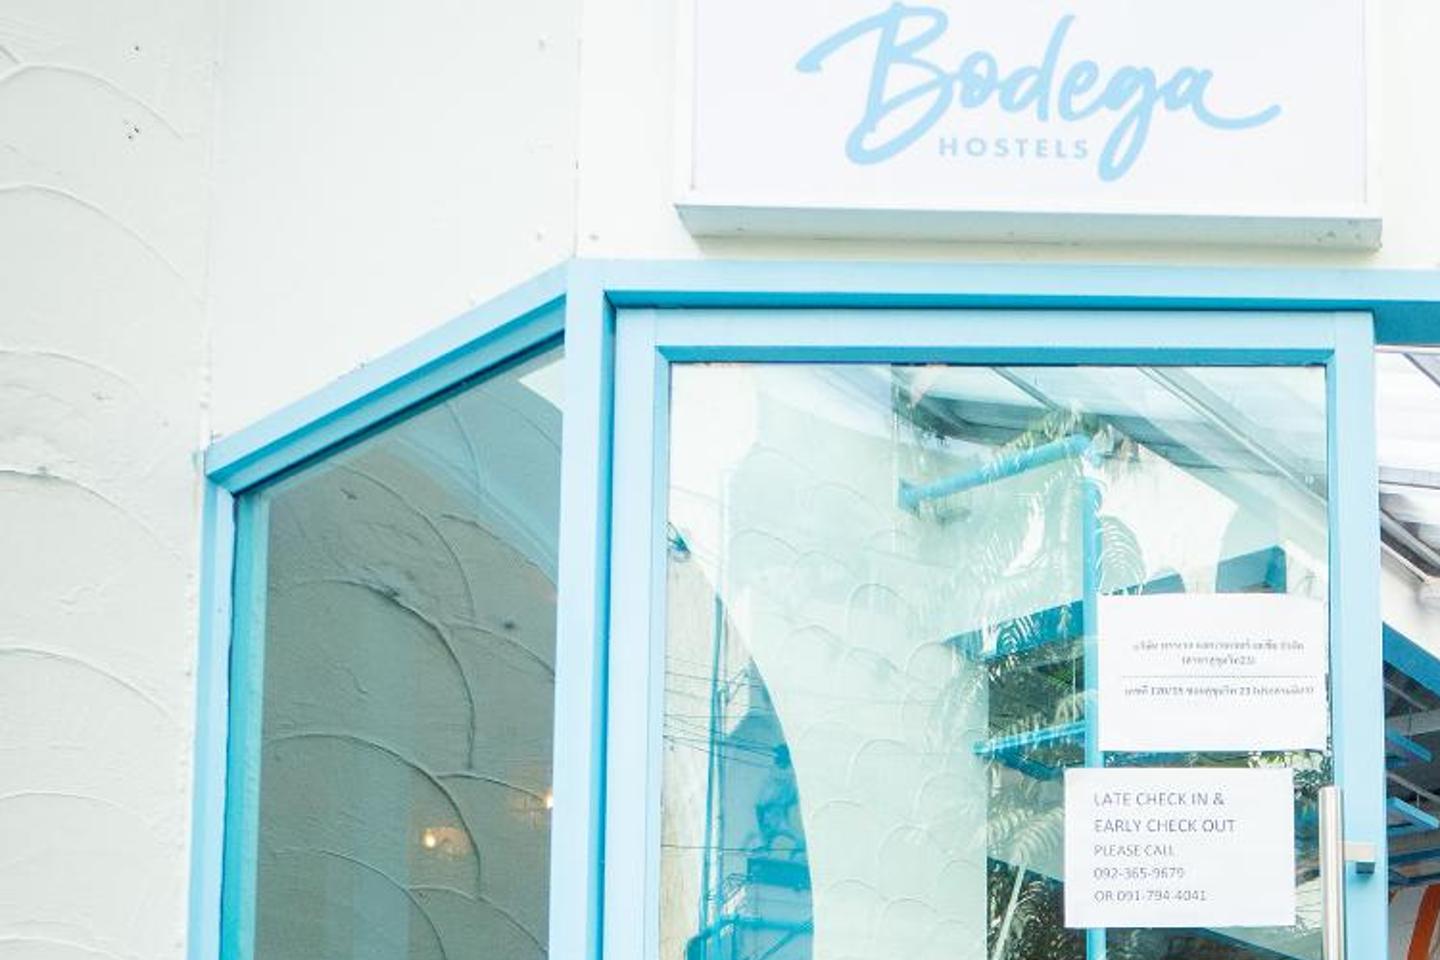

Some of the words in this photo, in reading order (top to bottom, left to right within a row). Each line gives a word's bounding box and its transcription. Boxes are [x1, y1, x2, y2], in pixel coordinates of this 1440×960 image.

[795, 1, 1282, 182] Bodega
[938, 136, 1089, 160] HOSTELS
[1093, 791, 1132, 807] LATE
[1136, 791, 1187, 807] CHECK
[1191, 791, 1209, 806] IN
[1212, 791, 1226, 806] &
[1093, 818, 1142, 833] EARLY
[1145, 818, 1198, 833] CHECK
[1201, 818, 1237, 833] OUT
[1093, 843, 1142, 857] PLEASE
[1143, 843, 1175, 857] CALL
[1093, 889, 1114, 902] OR
